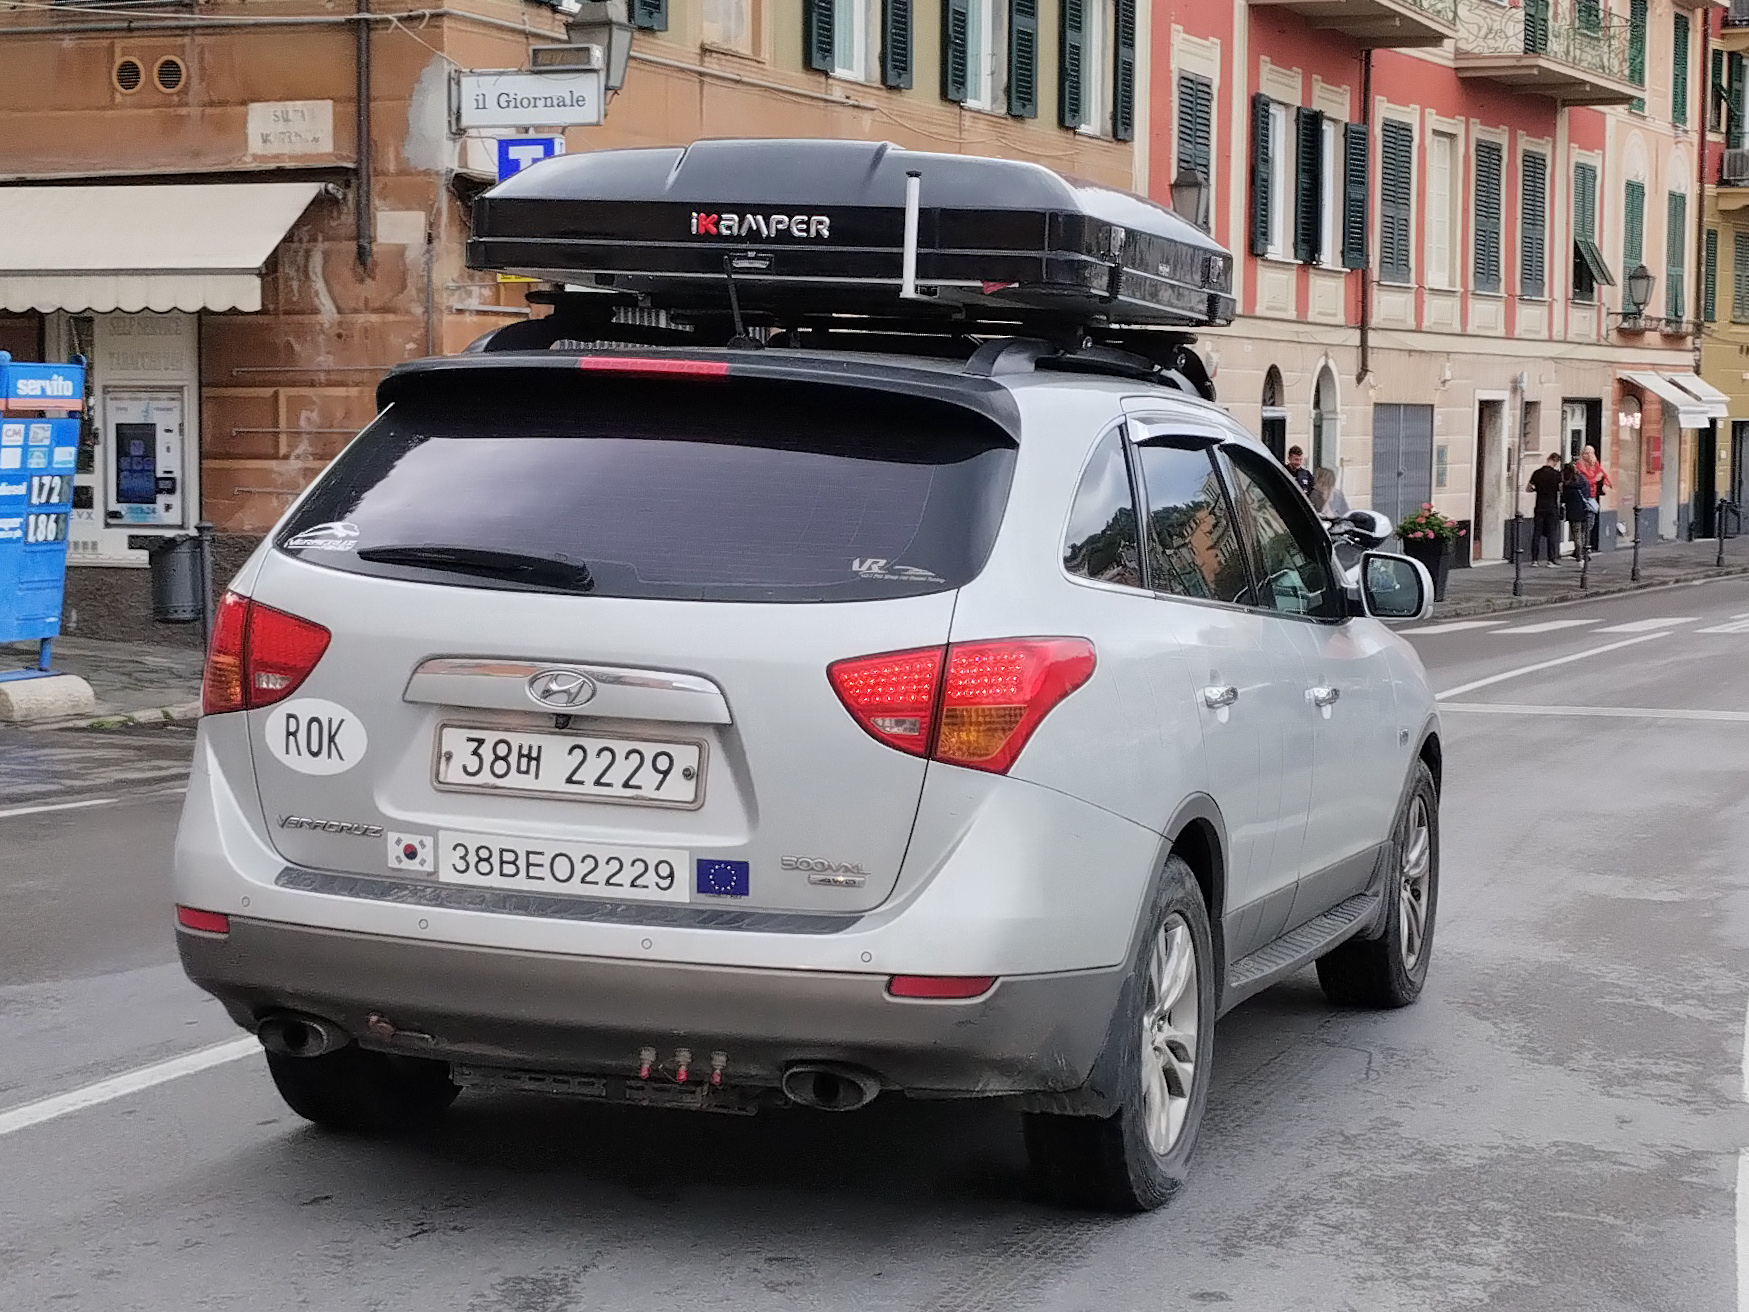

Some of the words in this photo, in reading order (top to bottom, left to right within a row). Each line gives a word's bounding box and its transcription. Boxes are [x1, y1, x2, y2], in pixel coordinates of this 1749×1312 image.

[474, 92, 489, 110] il
[496, 91, 587, 110] Giornale
[508, 145, 545, 171] T
[285, 713, 345, 761] ROK
[565, 743, 675, 791] 2229
[277, 814, 384, 838] VERACRUZ
[451, 842, 675, 891] 38BEO2229
